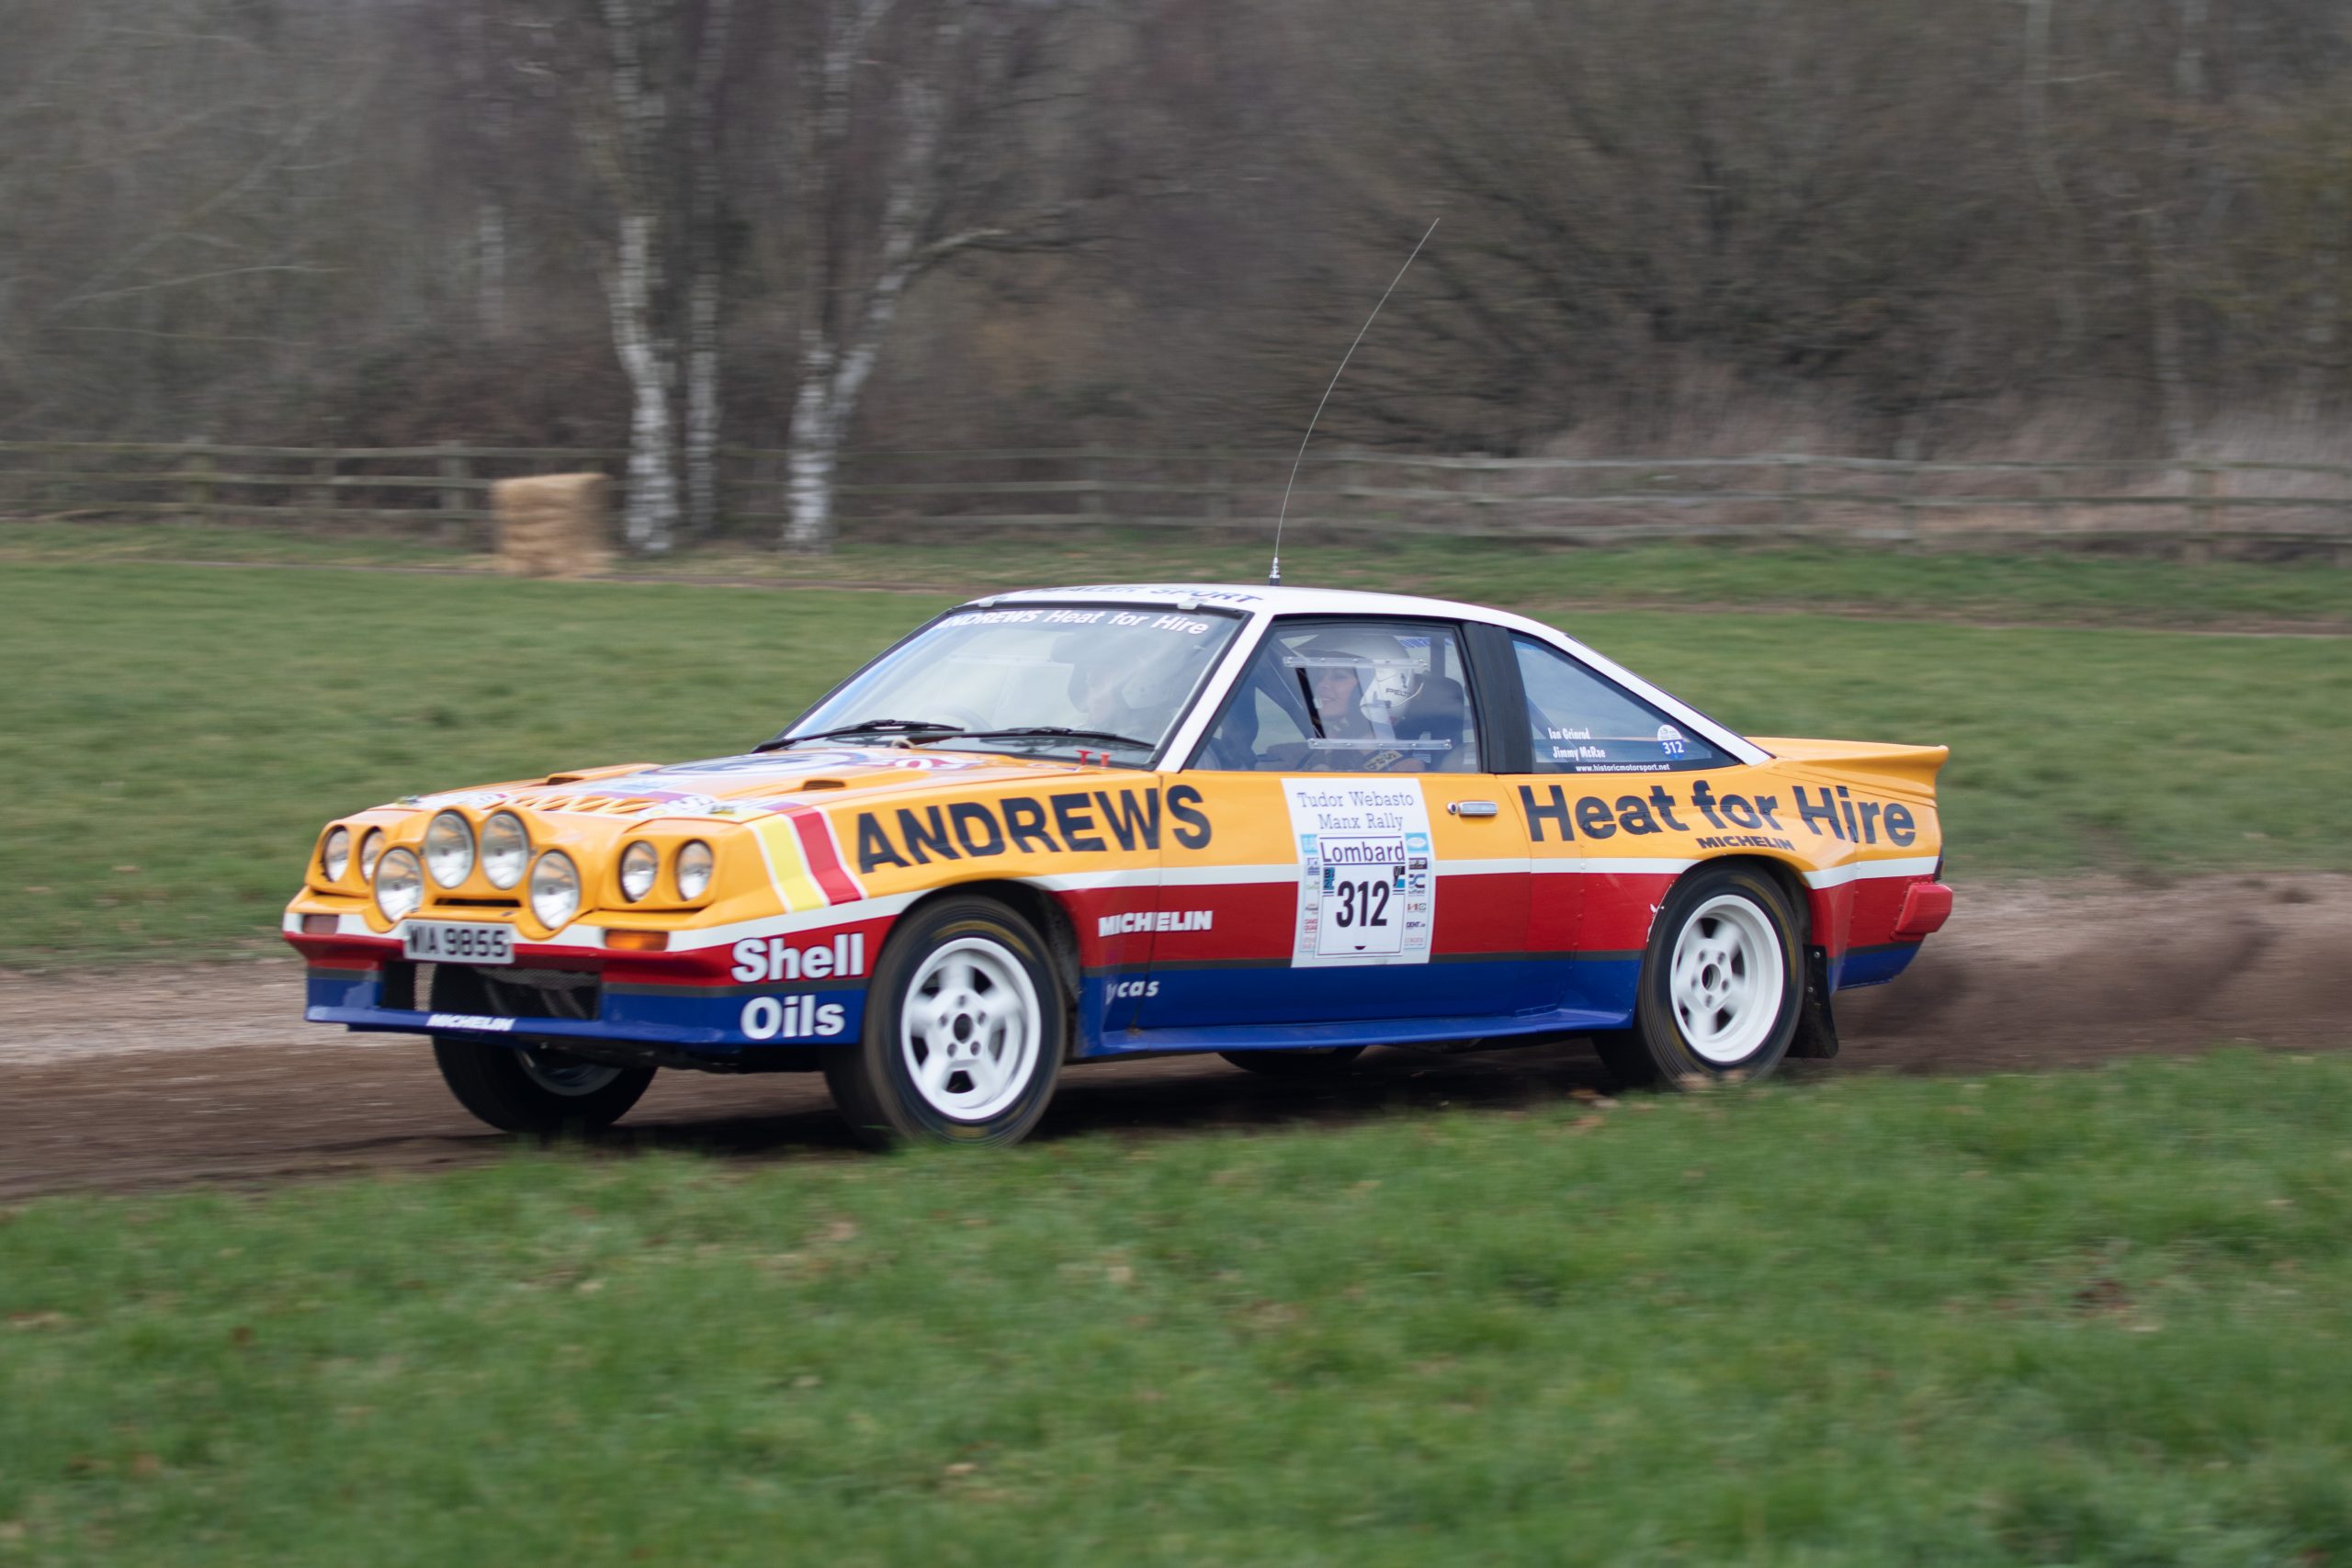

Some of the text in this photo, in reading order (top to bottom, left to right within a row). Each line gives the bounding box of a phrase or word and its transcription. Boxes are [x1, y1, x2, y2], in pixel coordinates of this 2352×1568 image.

[1043, 610, 1105, 625] Heat
[1107, 612, 1150, 626] for
[1149, 615, 1210, 636] Hire
[1548, 728, 1562, 739] Ian
[1553, 746, 1606, 761] Jimmy McRae
[1662, 740, 1684, 755] 312
[1576, 763, 1670, 773] www.historicmotorsport.net
[1296, 790, 1415, 808] Tudor Webasto
[1317, 813, 1404, 831] Manx Rally
[1518, 780, 1917, 848] Heat for Hire
[857, 784, 1211, 874] ANDREWS
[1320, 840, 1406, 863] Lombard
[1696, 836, 1796, 852] MICHELIN
[1336, 880, 1390, 928] 312
[1098, 910, 1213, 937] MICHELIN
[445, 928, 506, 957] 9855
[730, 932, 865, 983] Shell
[425, 1014, 516, 1032] MICHELIN
[740, 994, 846, 1040] Oils
